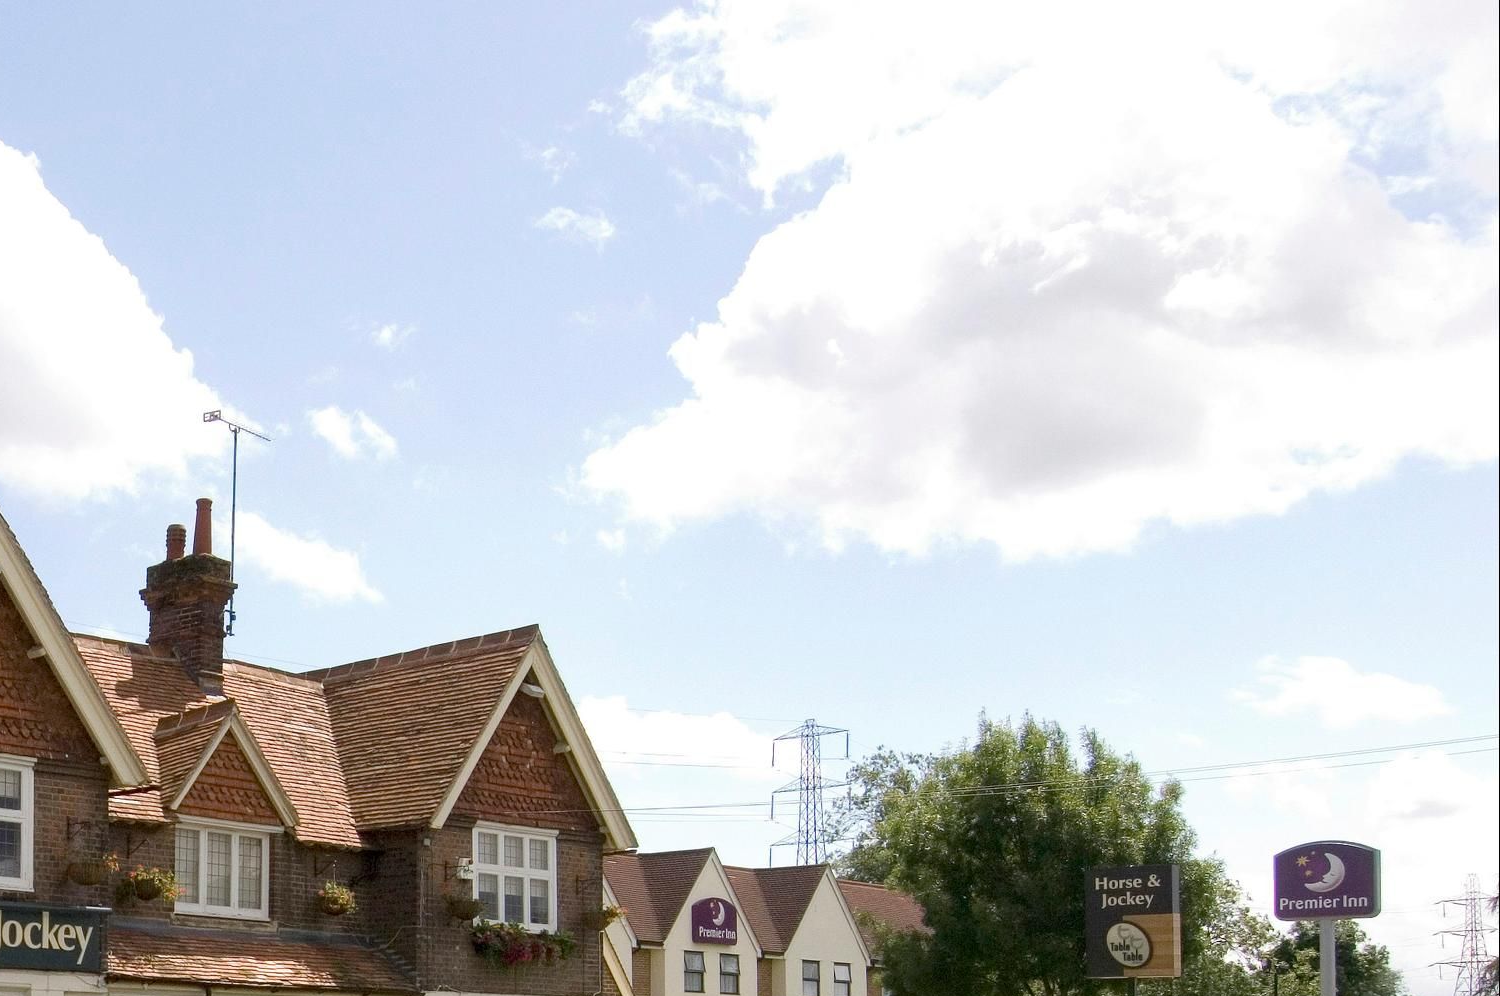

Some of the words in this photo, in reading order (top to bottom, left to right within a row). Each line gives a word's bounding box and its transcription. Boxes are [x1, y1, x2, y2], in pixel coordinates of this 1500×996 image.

[1095, 877, 1142, 890] Horse
[1147, 874, 1161, 887] &
[1101, 891, 1154, 909] Jockey
[1280, 896, 1340, 910] Premier
[1343, 895, 1368, 908] Inn
[699, 926, 725, 938] Premier
[725, 928, 736, 940] Inn
[1110, 940, 1130, 951] Table
[1122, 949, 1143, 961] Table
